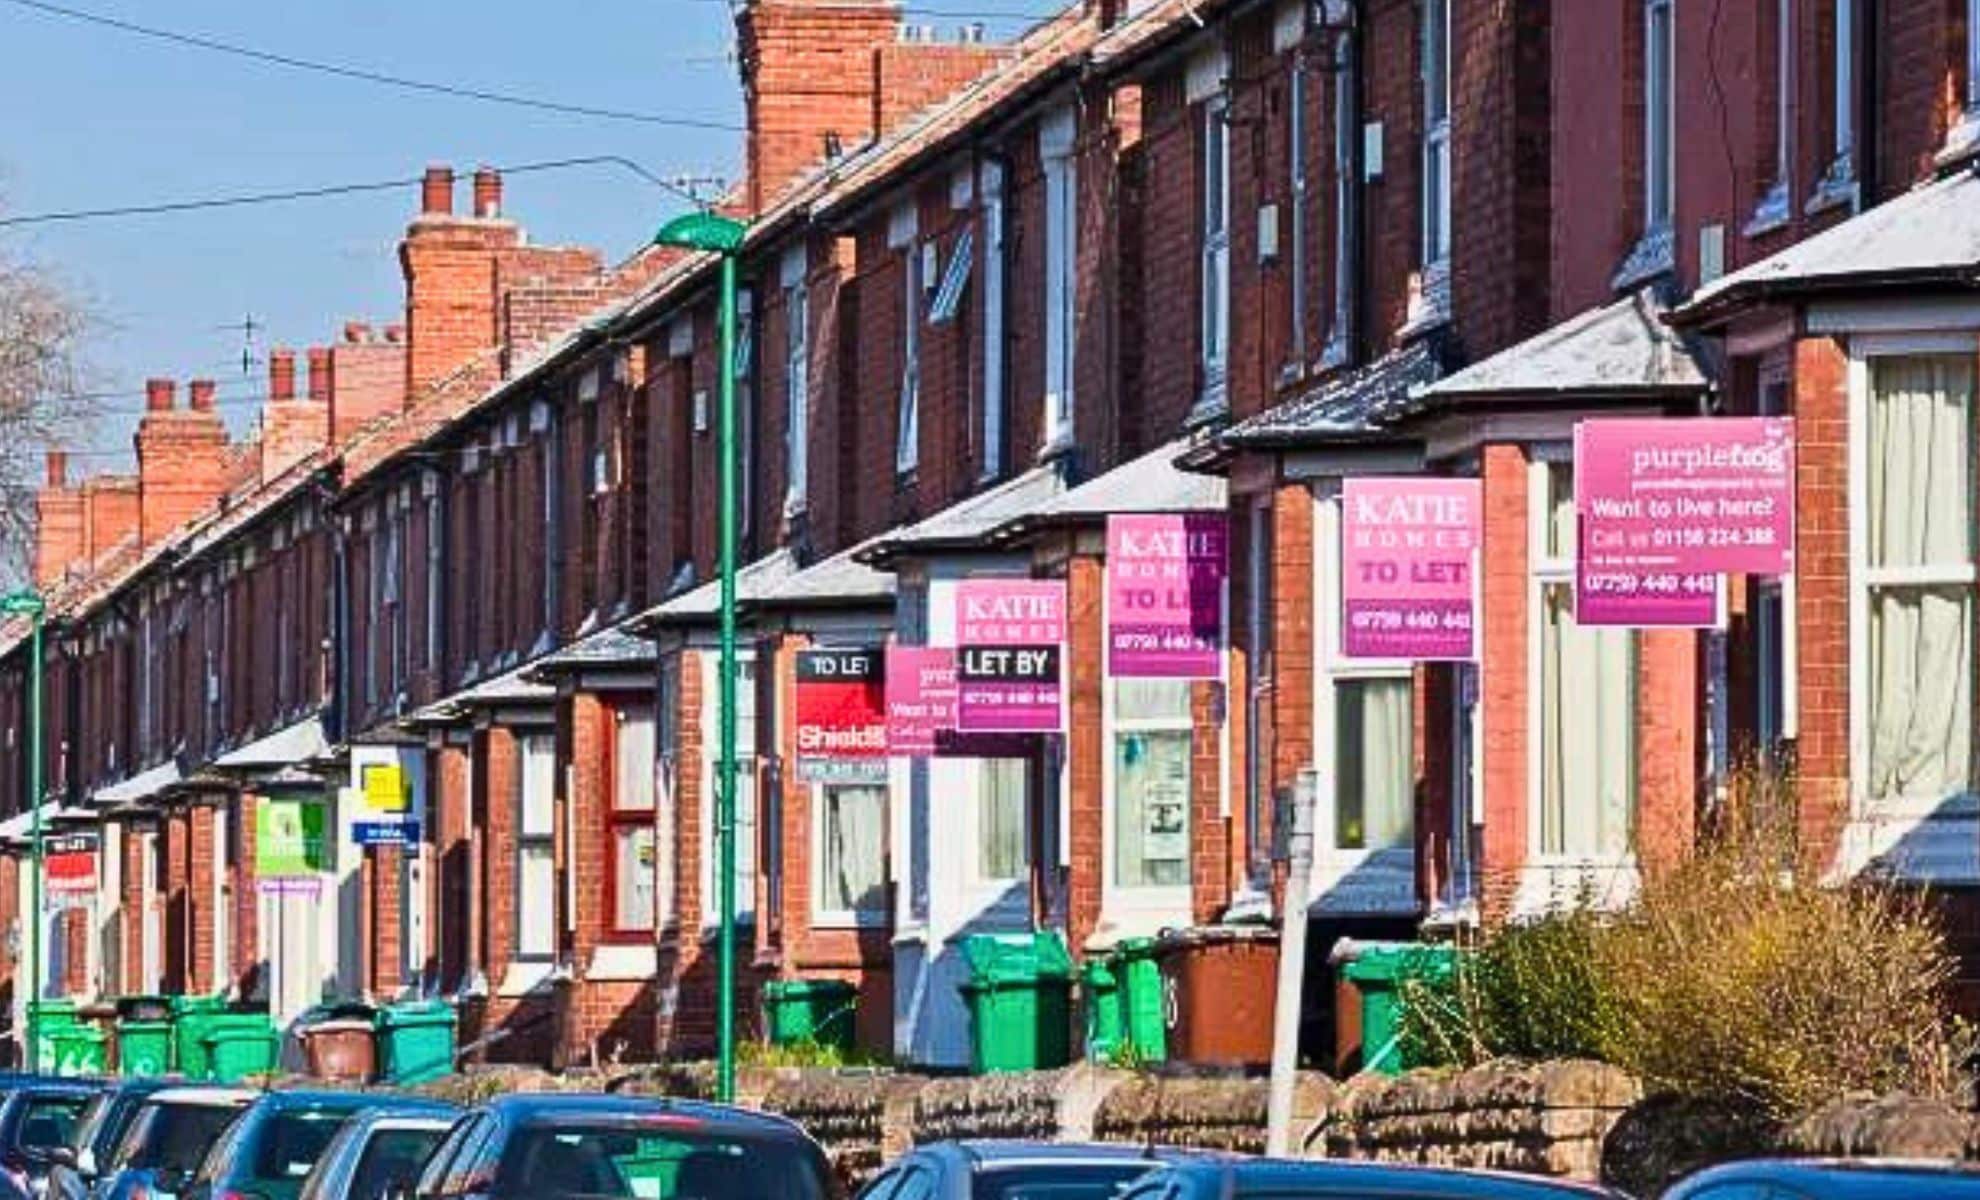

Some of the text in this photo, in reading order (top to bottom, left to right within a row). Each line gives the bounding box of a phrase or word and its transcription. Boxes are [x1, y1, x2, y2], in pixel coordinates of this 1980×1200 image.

[1633, 443, 1785, 475] purplefrog
[1357, 494, 1467, 524] KATIE
[1591, 496, 1775, 518] Want to live here?
[1119, 529, 1218, 557] KATIE
[1355, 530, 1471, 548] HOMES
[1591, 528, 1624, 547] Call
[1359, 561, 1467, 583] TO LET
[965, 595, 1058, 619] KATIE
[1120, 589, 1155, 608] TO
[812, 656, 869, 675] TO LET
[965, 650, 1048, 675] LET BY
